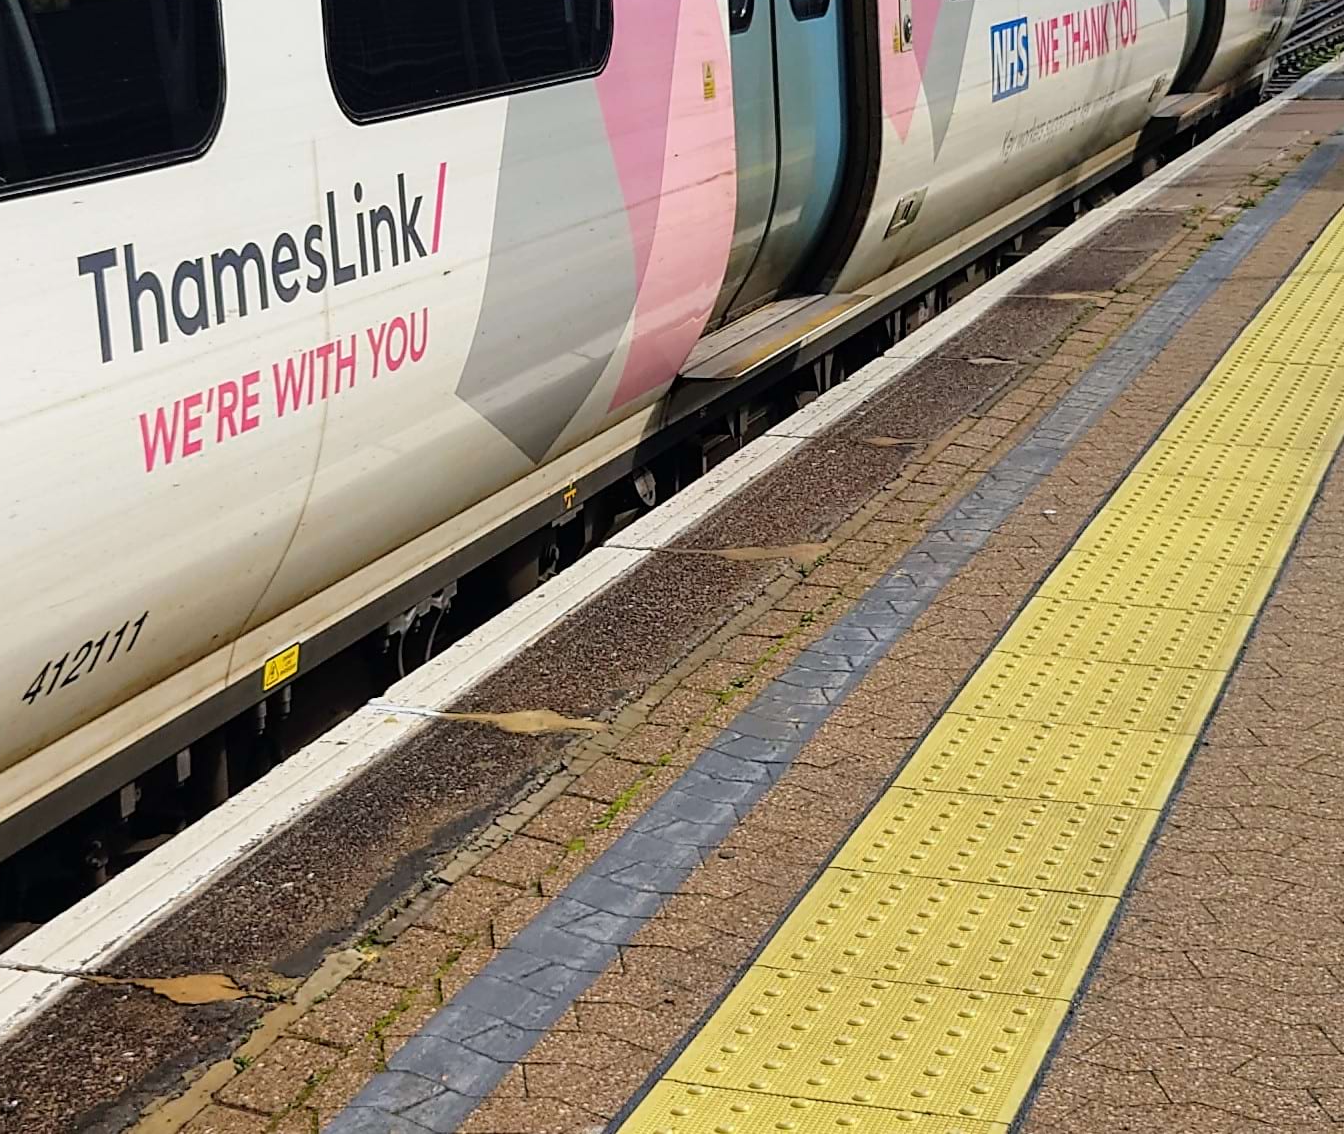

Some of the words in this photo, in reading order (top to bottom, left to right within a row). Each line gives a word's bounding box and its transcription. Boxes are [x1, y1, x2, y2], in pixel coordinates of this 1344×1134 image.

[992, 22, 1028, 96] NHS
[1035, 18, 1059, 79] WE
[1062, 3, 1109, 69] THANK
[272, 334, 357, 418] WITH
[366, 307, 428, 379] YOU
[22, 611, 149, 705] 412111
